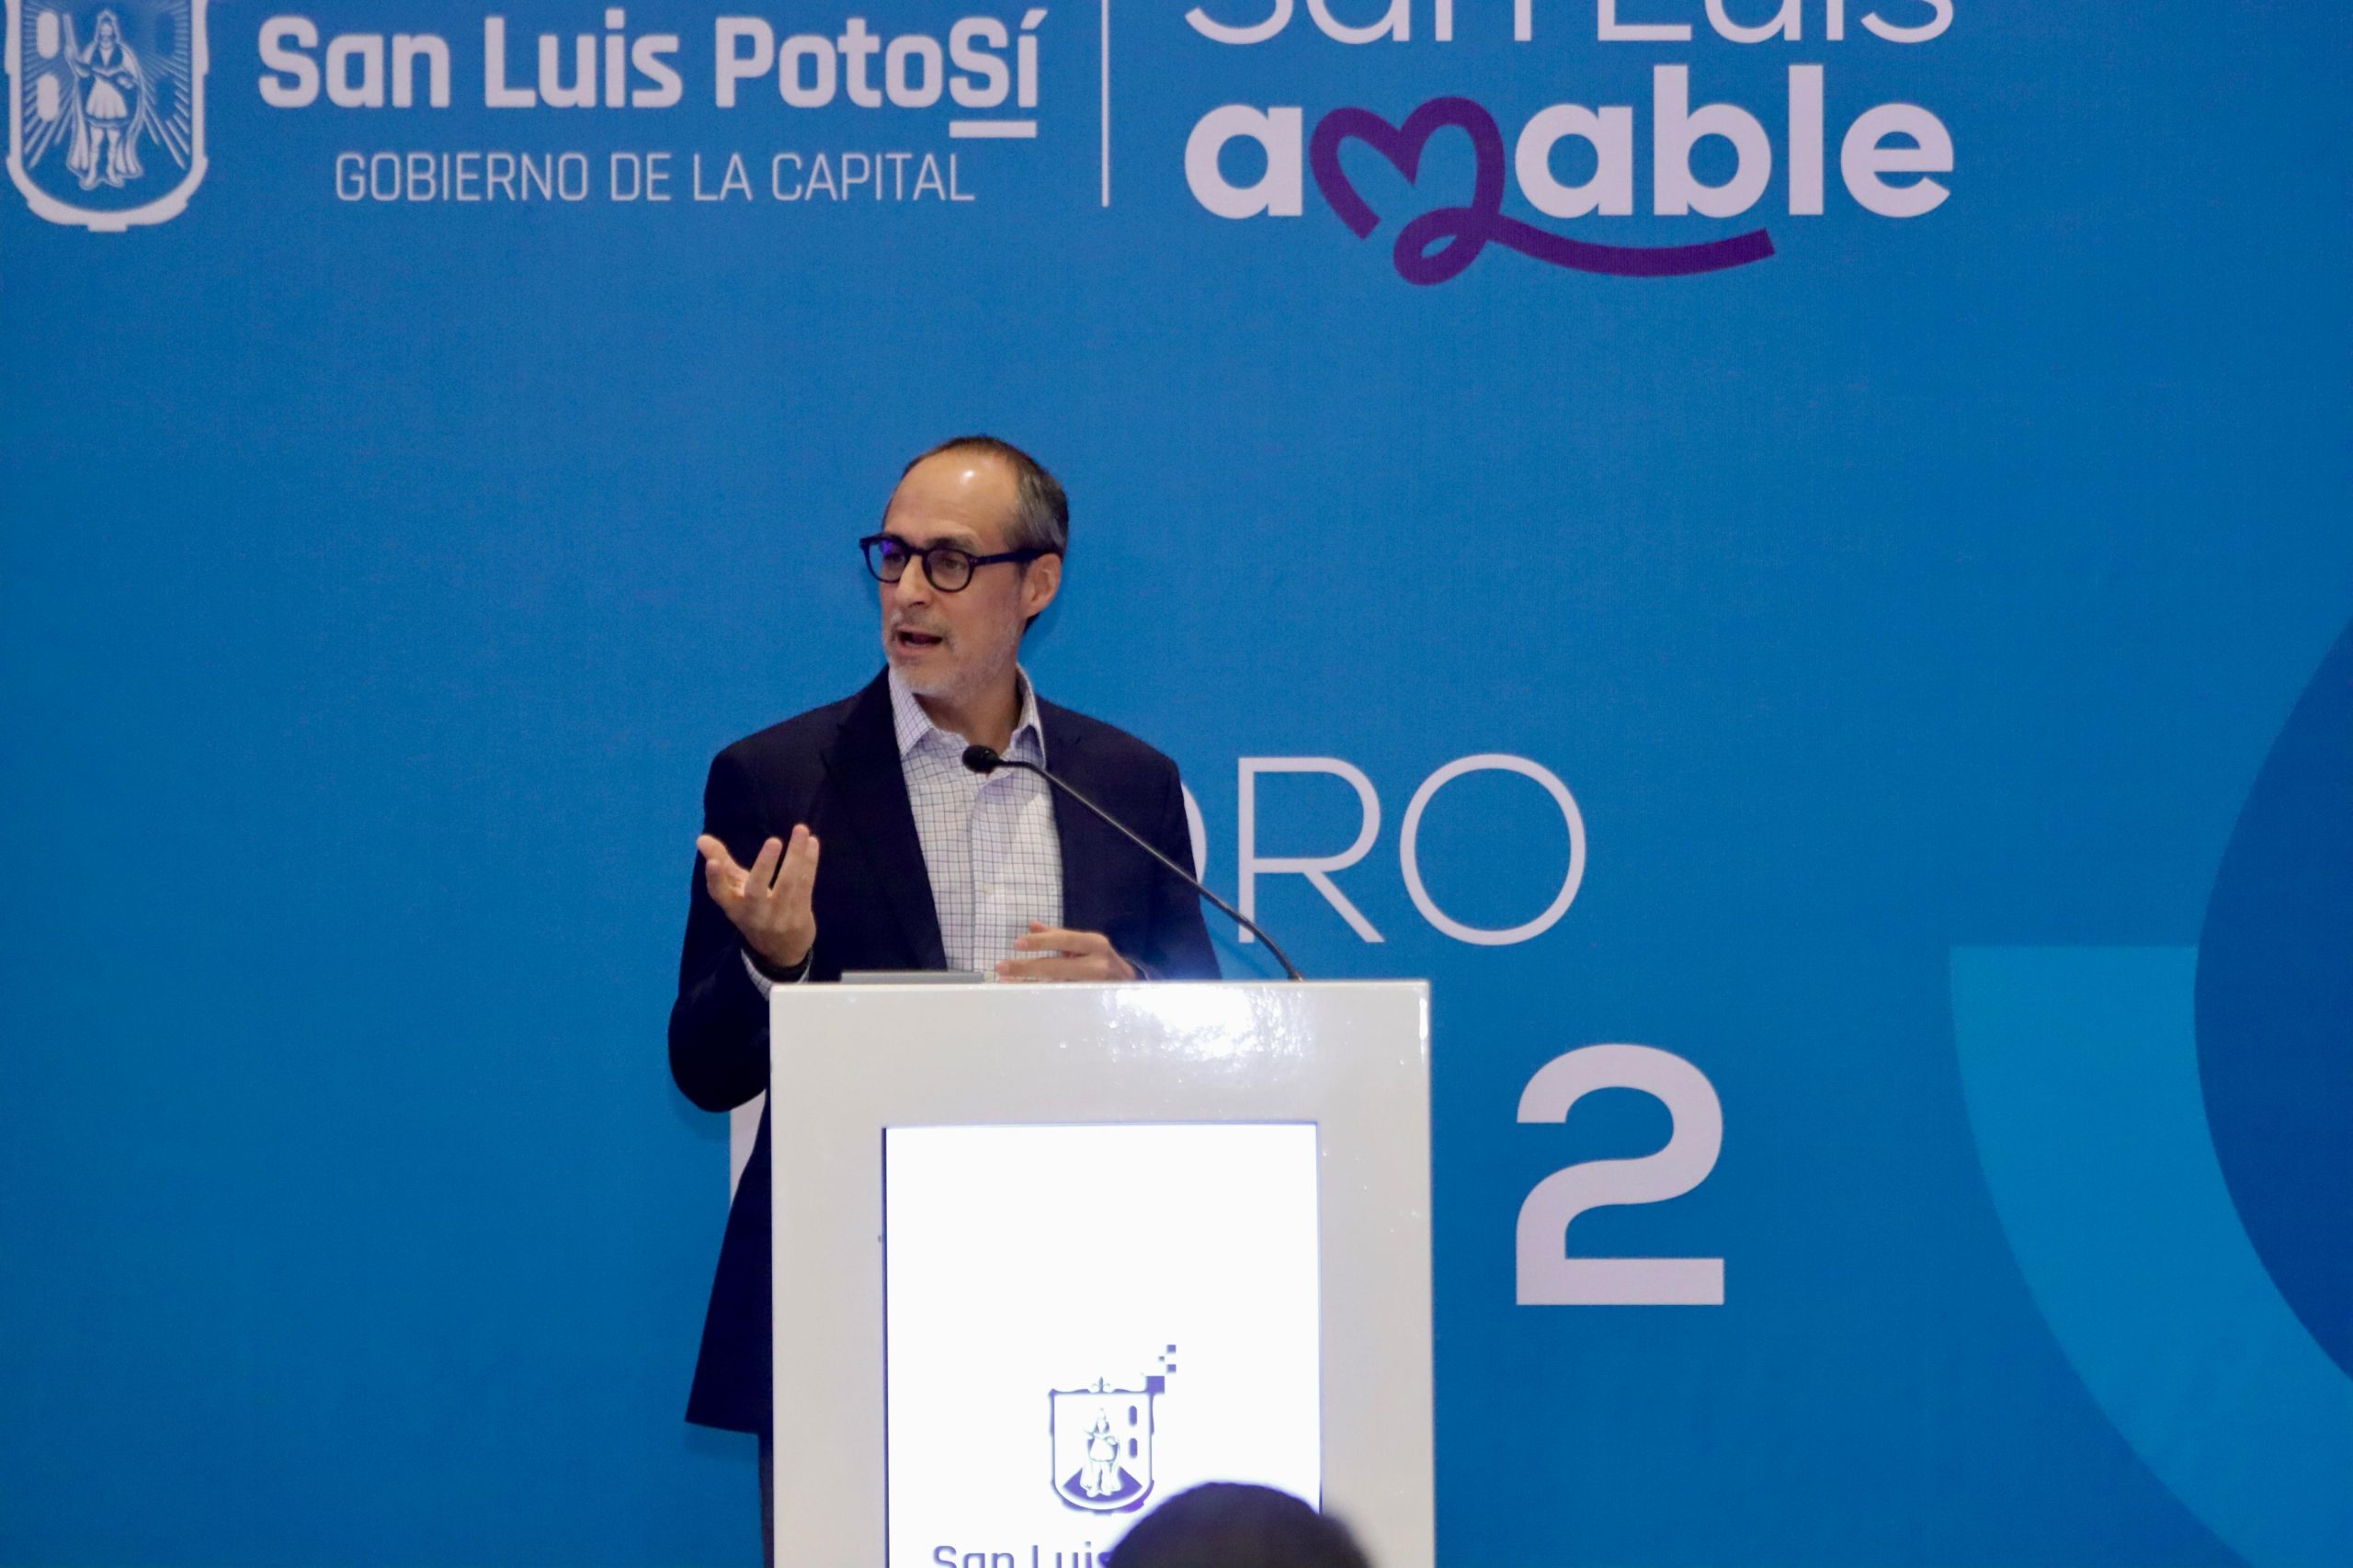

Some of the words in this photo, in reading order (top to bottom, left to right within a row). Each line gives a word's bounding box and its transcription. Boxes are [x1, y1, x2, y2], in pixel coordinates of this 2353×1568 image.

[258, 16, 450, 108] San
[484, 7, 683, 108] Luis
[715, 8, 1049, 108] PotoSí
[335, 153, 588, 202] GOBIERNO
[610, 153, 672, 201] DE
[693, 153, 753, 201] LA
[772, 153, 976, 201] CAPITAL
[1183, 753, 1586, 946] RO
